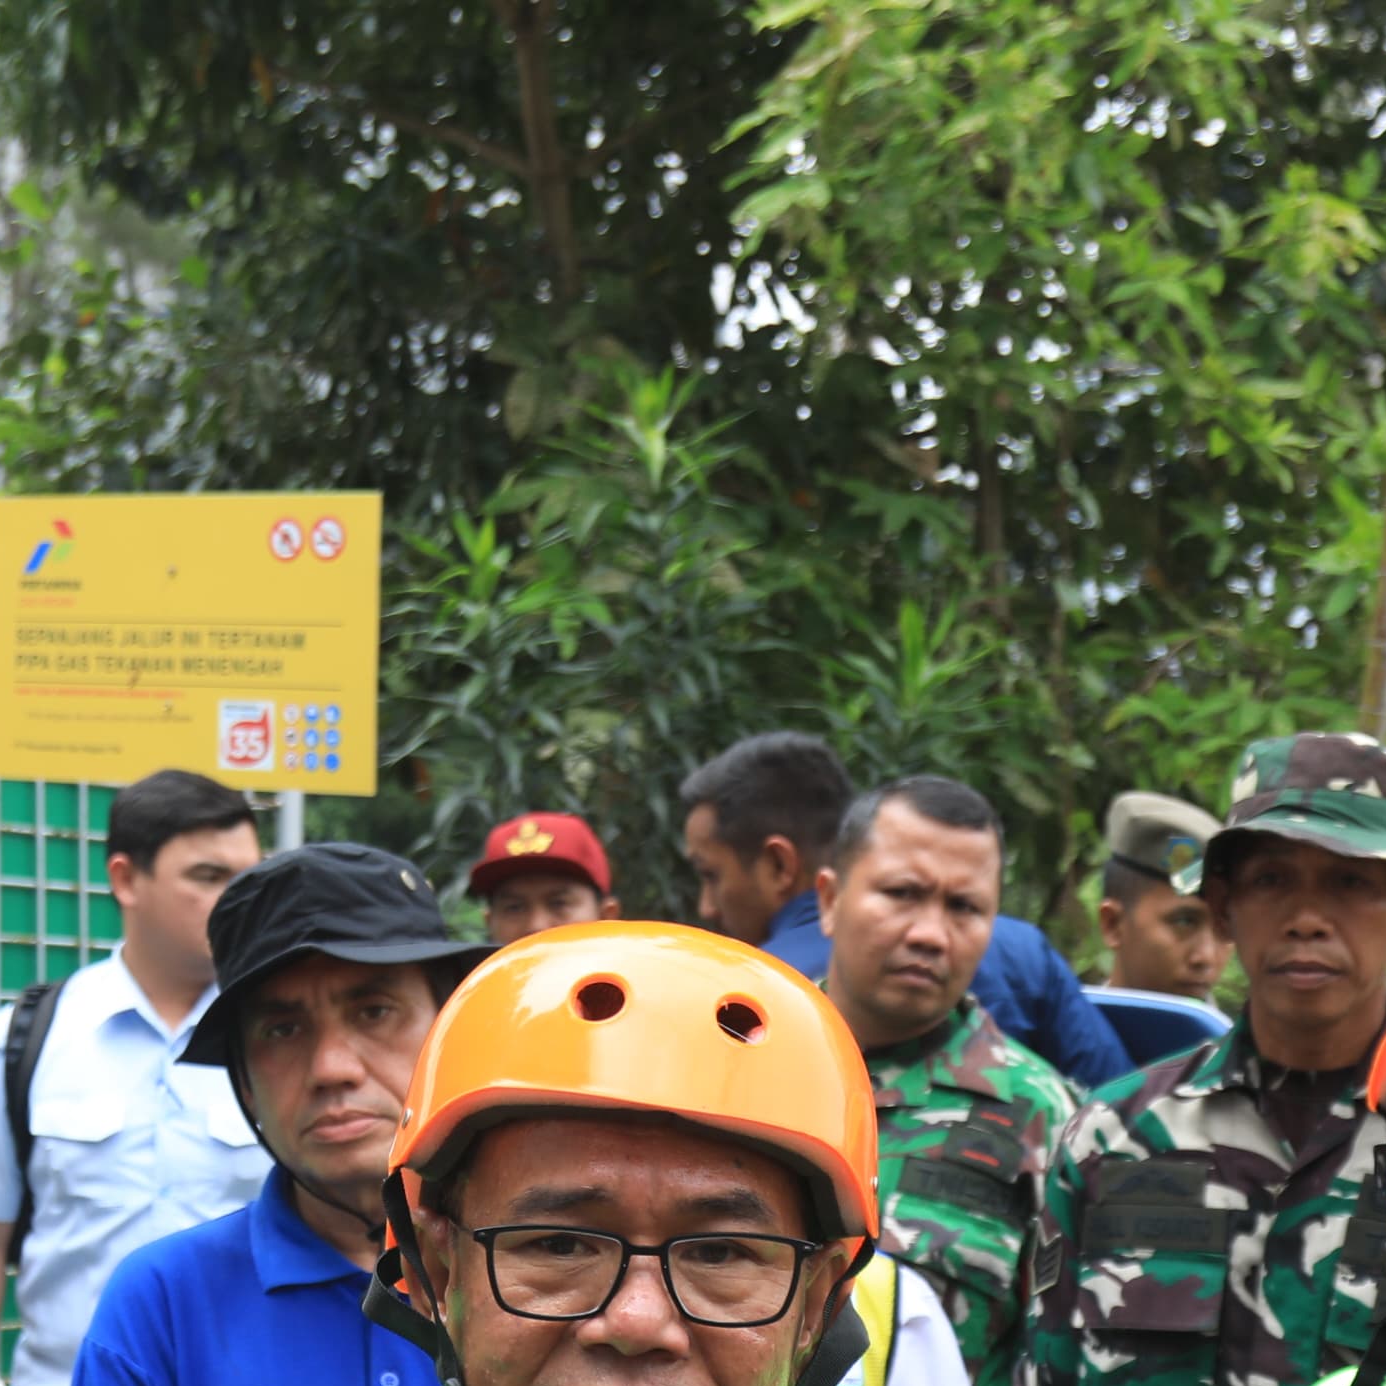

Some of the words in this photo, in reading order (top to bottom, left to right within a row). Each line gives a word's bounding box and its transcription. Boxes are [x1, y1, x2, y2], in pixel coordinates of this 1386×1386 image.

[119, 630, 174, 648] JALUR
[207, 631, 306, 650] TERTANAM
[15, 654, 52, 672] PIPA
[55, 654, 91, 674] GAS
[180, 657, 284, 676] MENENGAH
